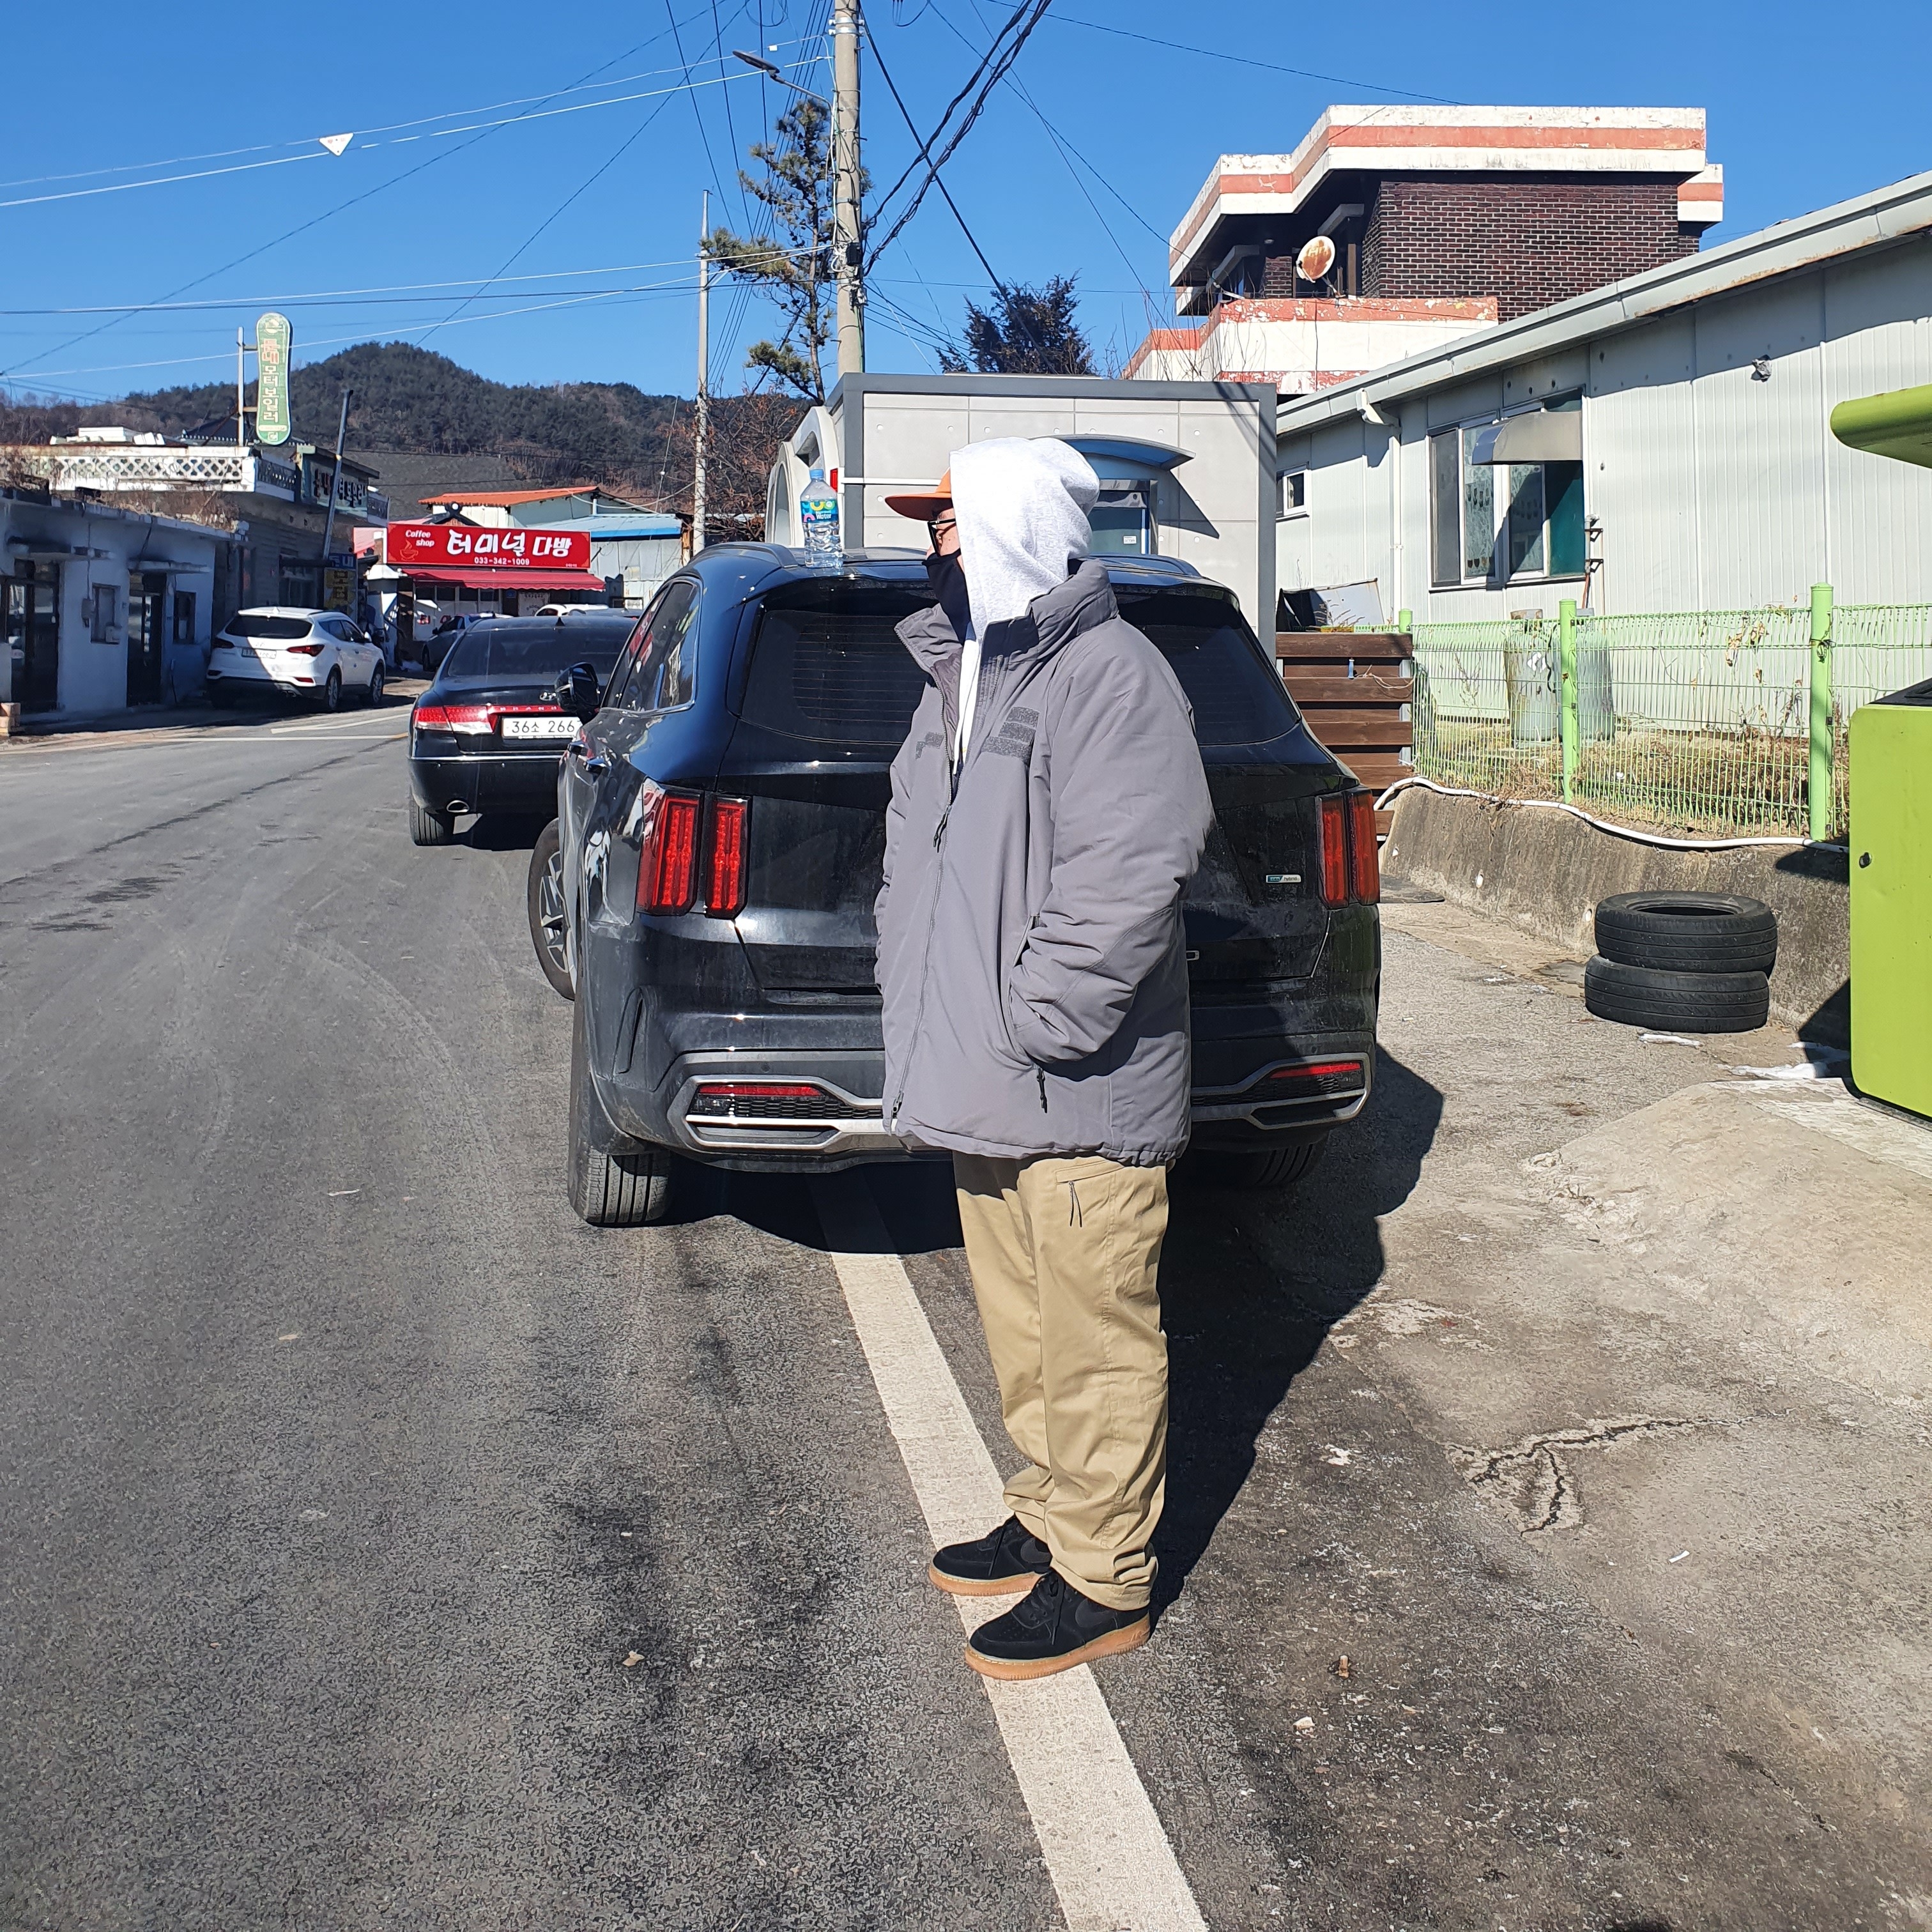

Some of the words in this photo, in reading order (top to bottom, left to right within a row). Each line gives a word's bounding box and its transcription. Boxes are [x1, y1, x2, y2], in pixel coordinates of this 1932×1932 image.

[405, 529, 431, 538] Coffee
[416, 539, 435, 548] shop
[447, 529, 526, 557] 터미널
[532, 536, 572, 558] 다방
[473, 557, 530, 565] 033-342-1009
[512, 720, 539, 733] 36소
[548, 720, 580, 733] 266
